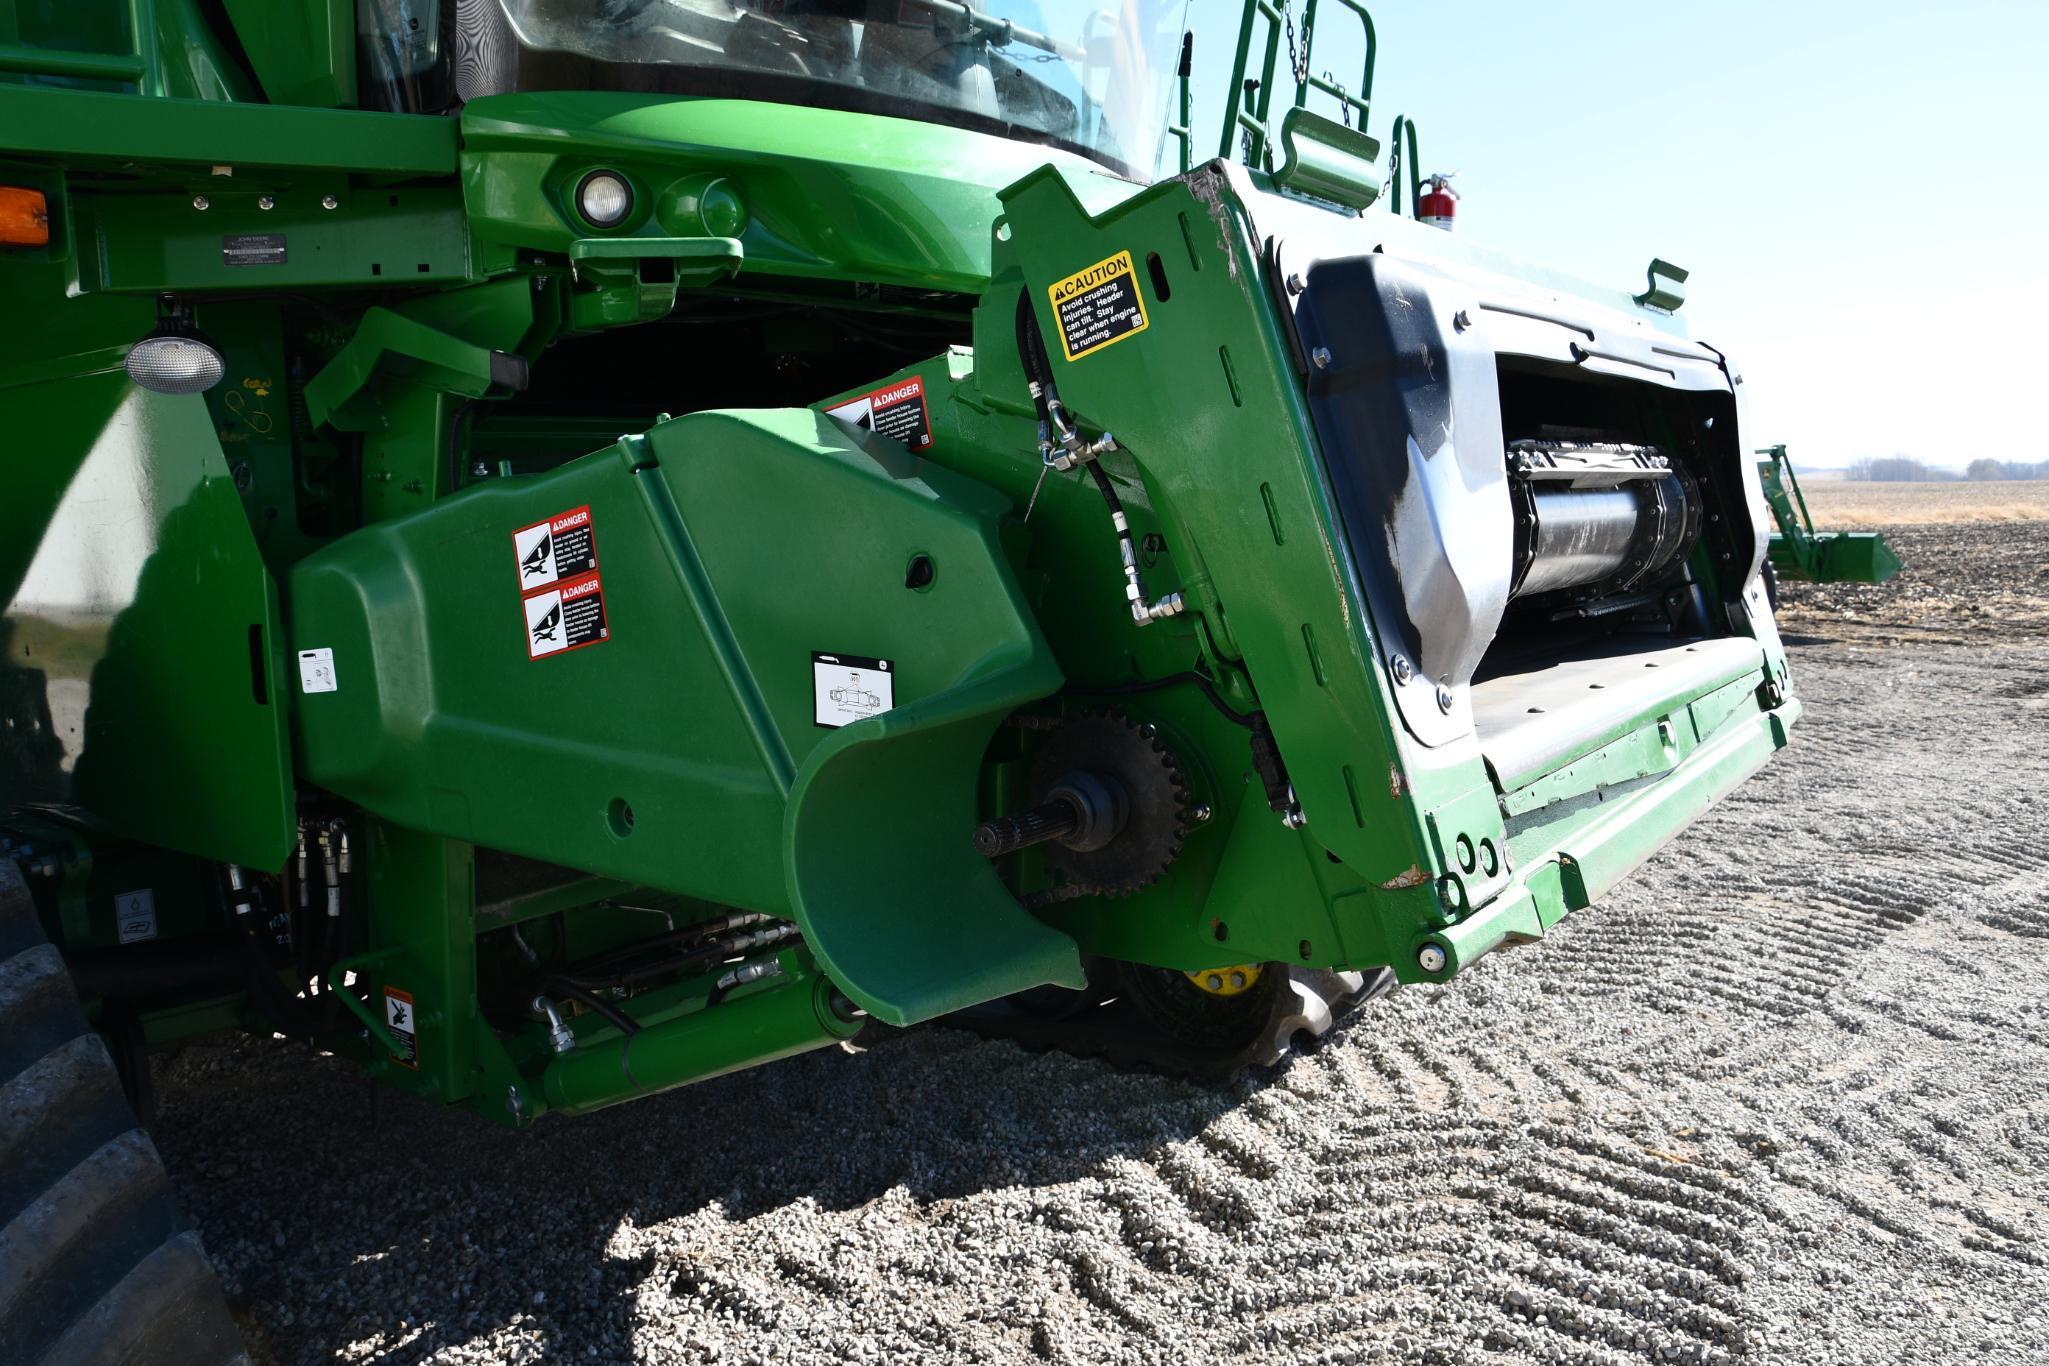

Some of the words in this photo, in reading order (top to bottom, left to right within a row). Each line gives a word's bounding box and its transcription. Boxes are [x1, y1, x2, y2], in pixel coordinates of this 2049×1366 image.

[1064, 256, 1127, 295] CAUTION
[1061, 297, 1083, 313] Avoid
[1084, 282, 1117, 303] crushing
[1063, 305, 1094, 323] injuries.
[1096, 290, 1124, 307] Header
[1066, 322, 1080, 331] can
[1082, 315, 1094, 325] tilt.
[1096, 306, 1114, 318] Stay
[1069, 329, 1087, 341] clear
[1089, 319, 1109, 332] when
[1111, 306, 1136, 323] engine
[1071, 342, 1078, 351] is
[1080, 330, 1112, 347] running.
[881, 384, 919, 404] DANGER
[558, 512, 587, 529] DANGER
[568, 580, 598, 596] DANGER
